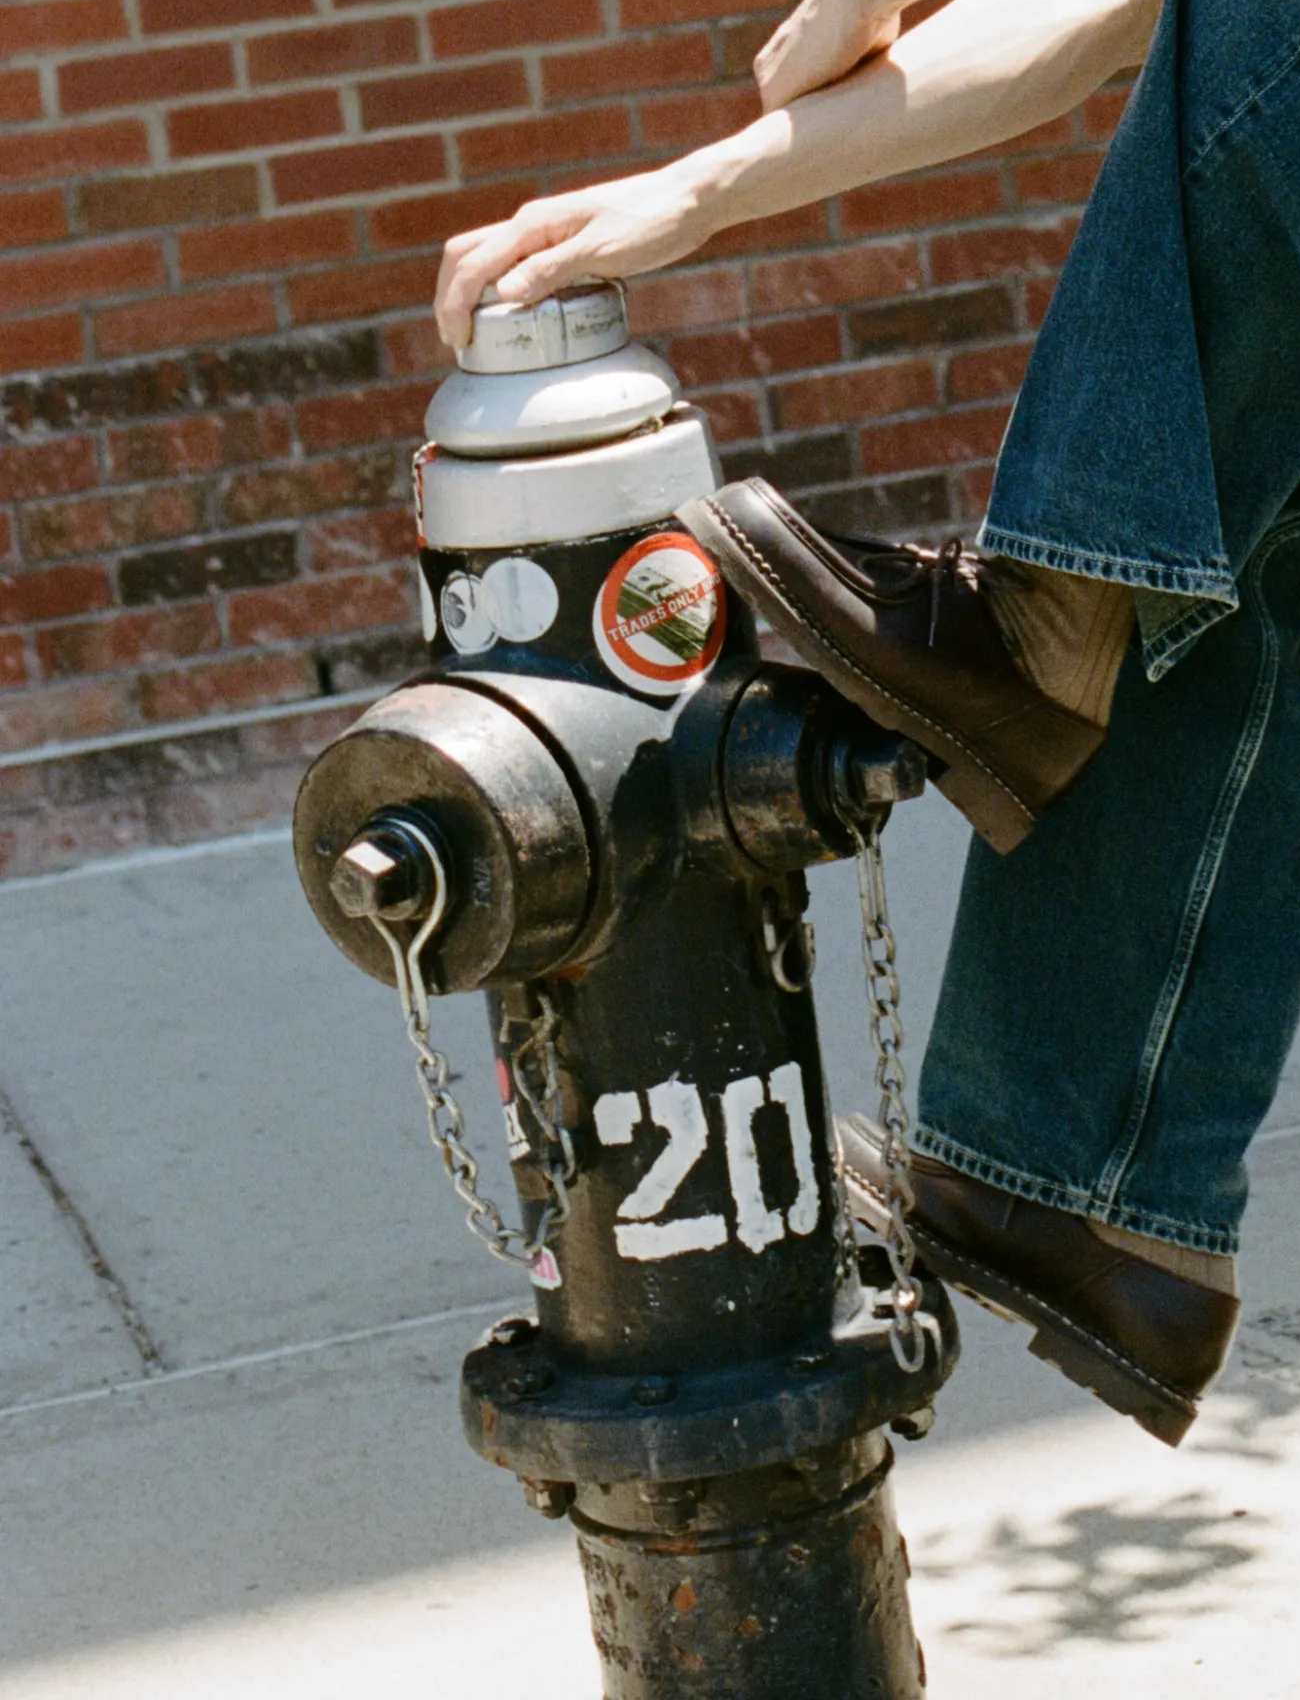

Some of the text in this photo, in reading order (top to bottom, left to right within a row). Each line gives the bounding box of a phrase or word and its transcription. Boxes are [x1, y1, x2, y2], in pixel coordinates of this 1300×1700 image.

[608, 607, 667, 641] TRADES
[668, 586, 700, 614] ONLY
[593, 1061, 820, 1262] 20
